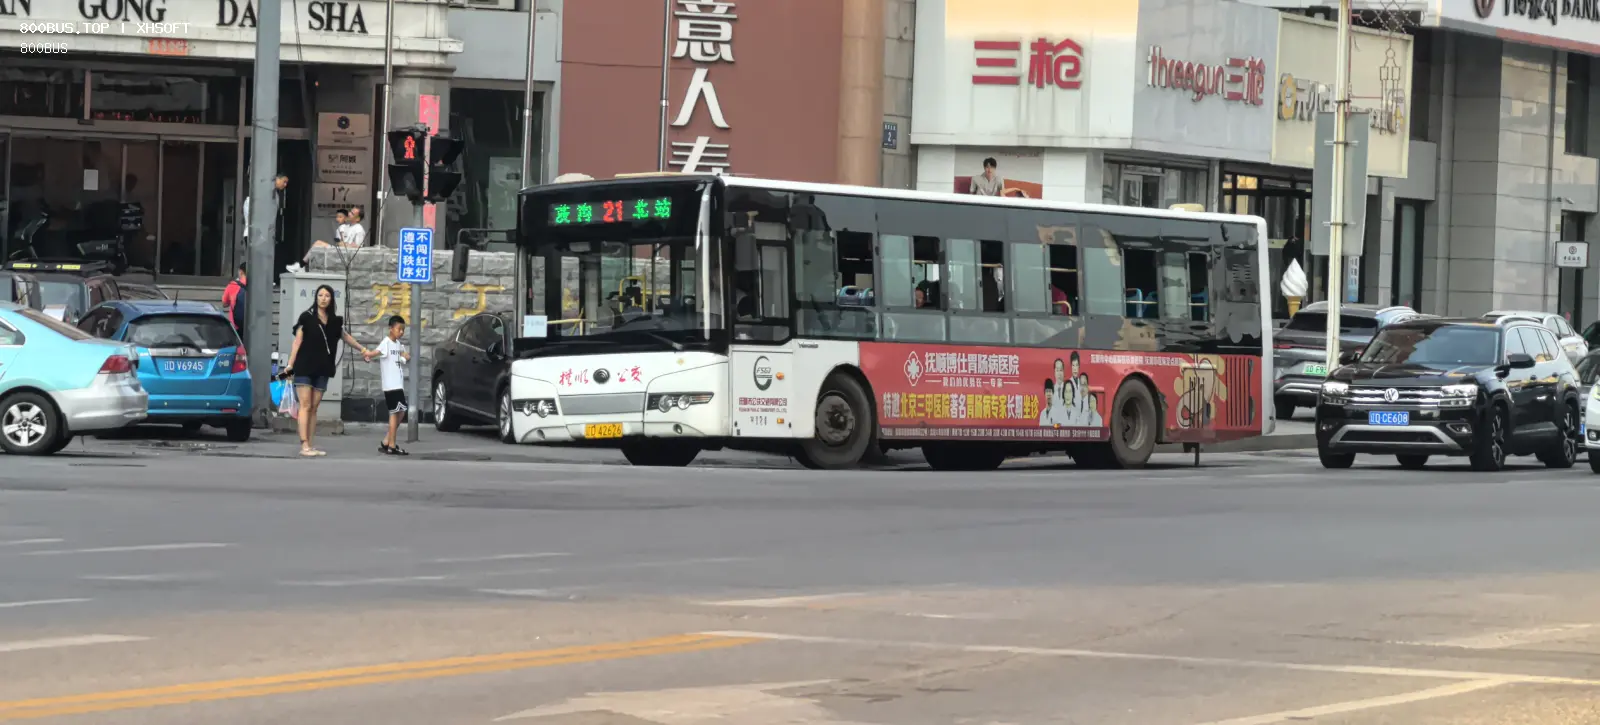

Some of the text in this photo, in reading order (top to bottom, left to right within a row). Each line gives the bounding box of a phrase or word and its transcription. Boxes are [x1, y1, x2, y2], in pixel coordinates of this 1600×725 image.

[79, 0, 167, 22] GONG
[215, 0, 257, 28] DA
[308, 1, 369, 34] SHA
[972, 37, 1083, 90] 三枪
[1148, 45, 1224, 102] threegun
[603, 200, 623, 222] 21
[632, 197, 672, 219] 北站
[402, 231, 415, 277] 遵守秩序
[416, 232, 428, 278] 不闯红灯
[177, 360, 203, 370] V6945
[925, 352, 1019, 374] 抚顺博仕胃肠病医院
[598, 423, 622, 437] 42626
